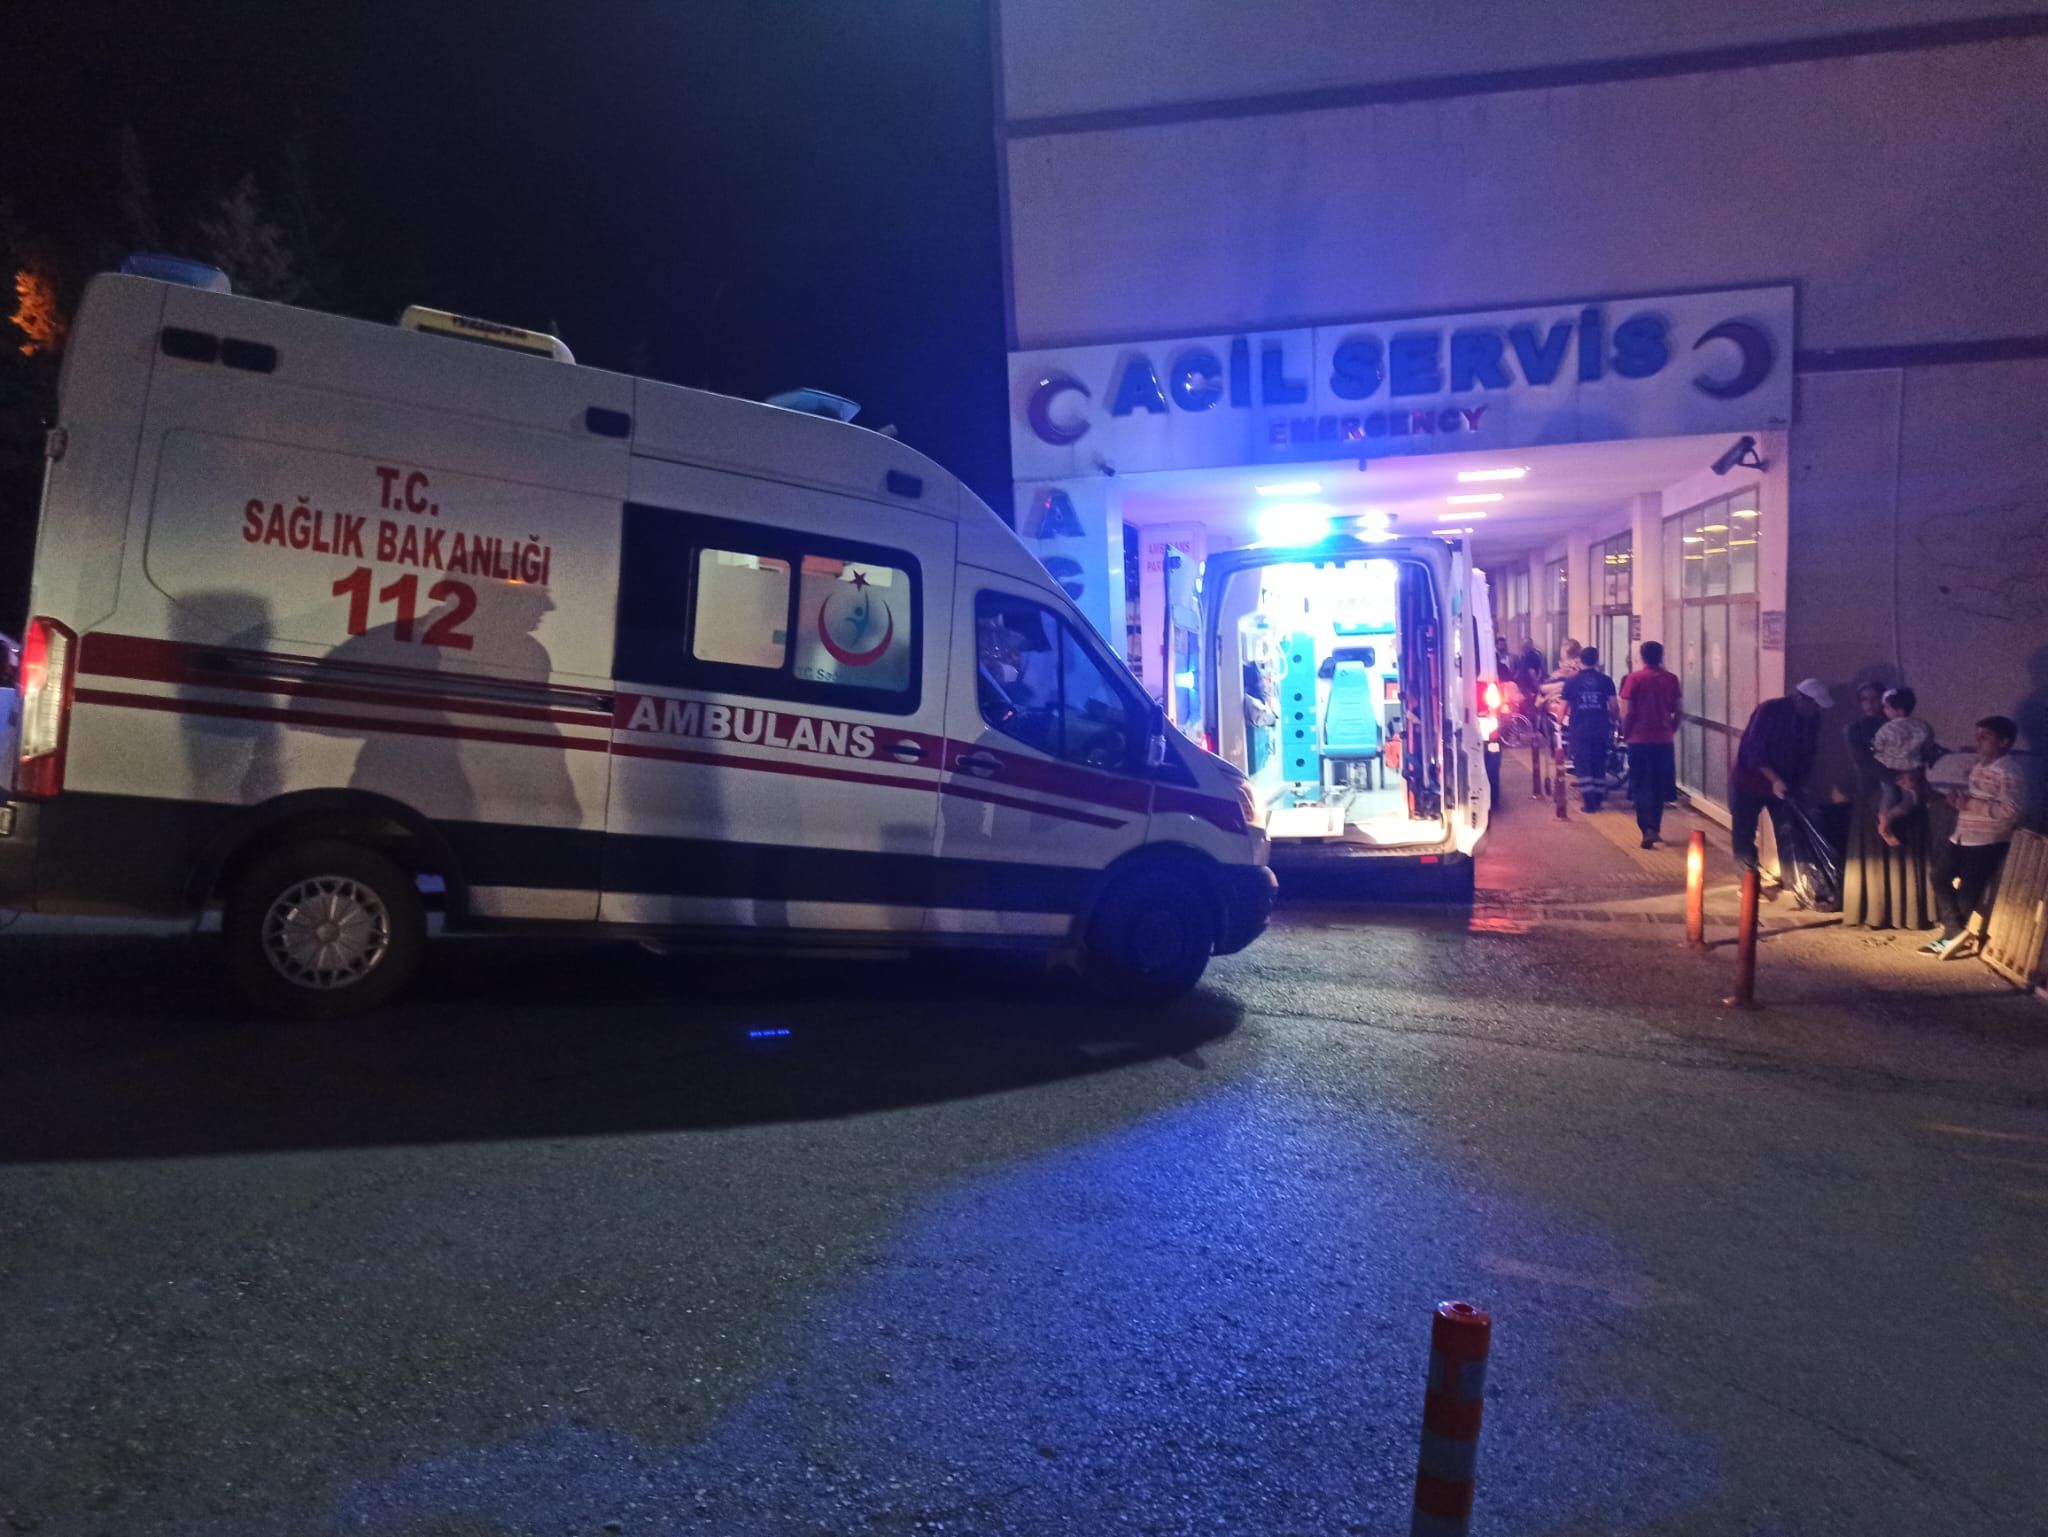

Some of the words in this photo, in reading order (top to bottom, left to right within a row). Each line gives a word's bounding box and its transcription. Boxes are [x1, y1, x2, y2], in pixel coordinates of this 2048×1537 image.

[1329, 304, 1672, 400] SERVİS
[1269, 405, 1487, 444] EMERGENCY
[376, 466, 439, 516] T.C.
[243, 495, 367, 558] SAĞLIK
[377, 519, 551, 586] BAKANLIĞI
[332, 566, 478, 650] 112
[626, 695, 876, 759] AMBULANS
